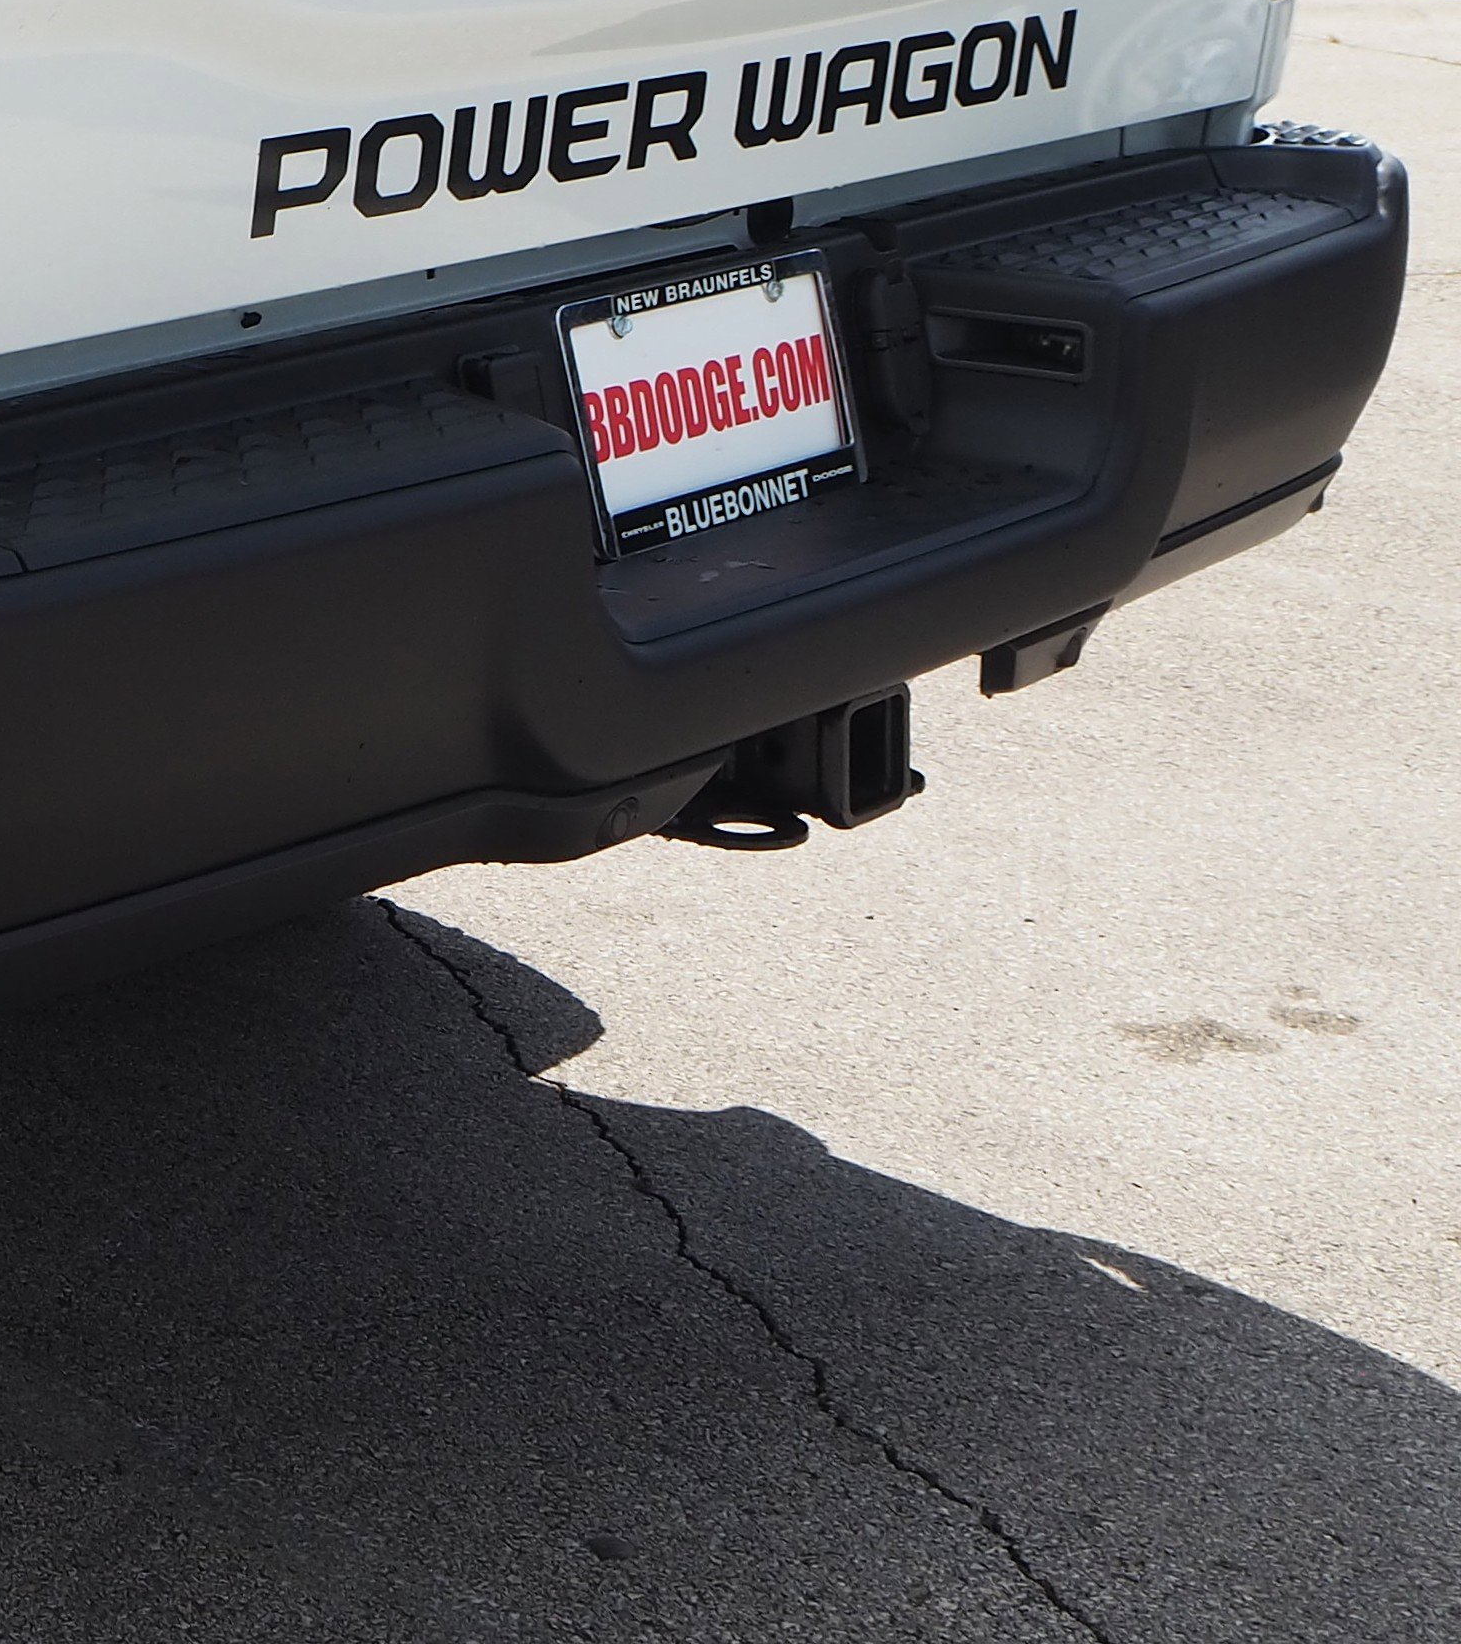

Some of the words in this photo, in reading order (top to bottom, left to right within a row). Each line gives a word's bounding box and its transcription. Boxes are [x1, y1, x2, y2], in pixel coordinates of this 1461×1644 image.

[250, 70, 707, 240] POWER
[733, 9, 1078, 148] WAGON
[616, 287, 661, 315] NEW
[665, 263, 774, 302] BRAUNFELS
[581, 333, 831, 464] BBDODGE.COM
[664, 467, 810, 538] BLUEBONNET
[811, 463, 854, 483] DODGE
